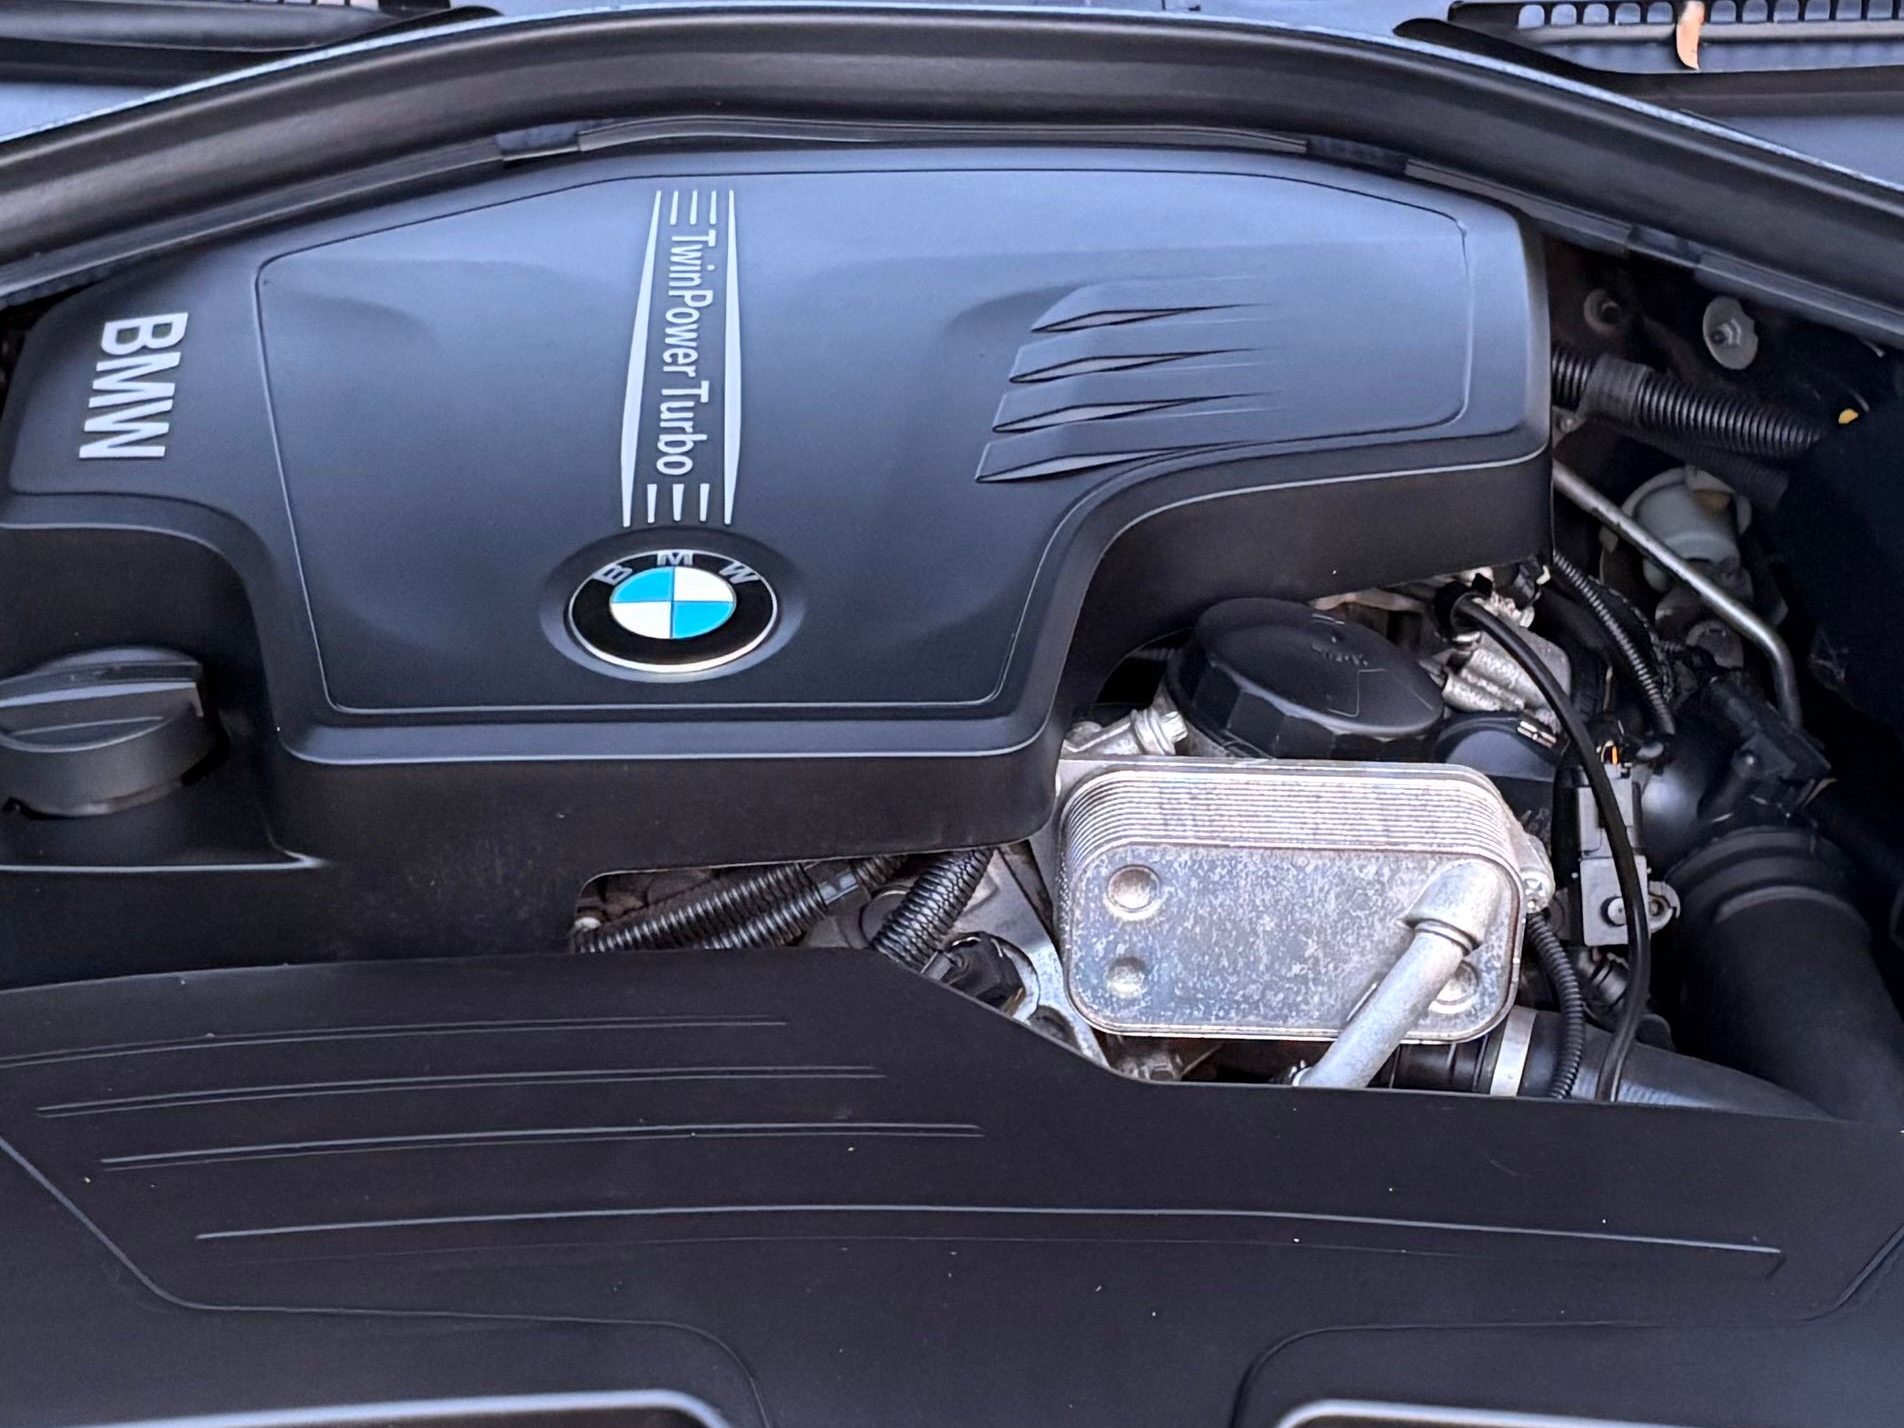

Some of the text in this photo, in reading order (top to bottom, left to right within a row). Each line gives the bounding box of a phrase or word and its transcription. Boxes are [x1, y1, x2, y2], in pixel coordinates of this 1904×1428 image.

[78, 312, 189, 459] BMW
[656, 229, 718, 477] TwinPower Turbo
[592, 550, 760, 585] BMW
